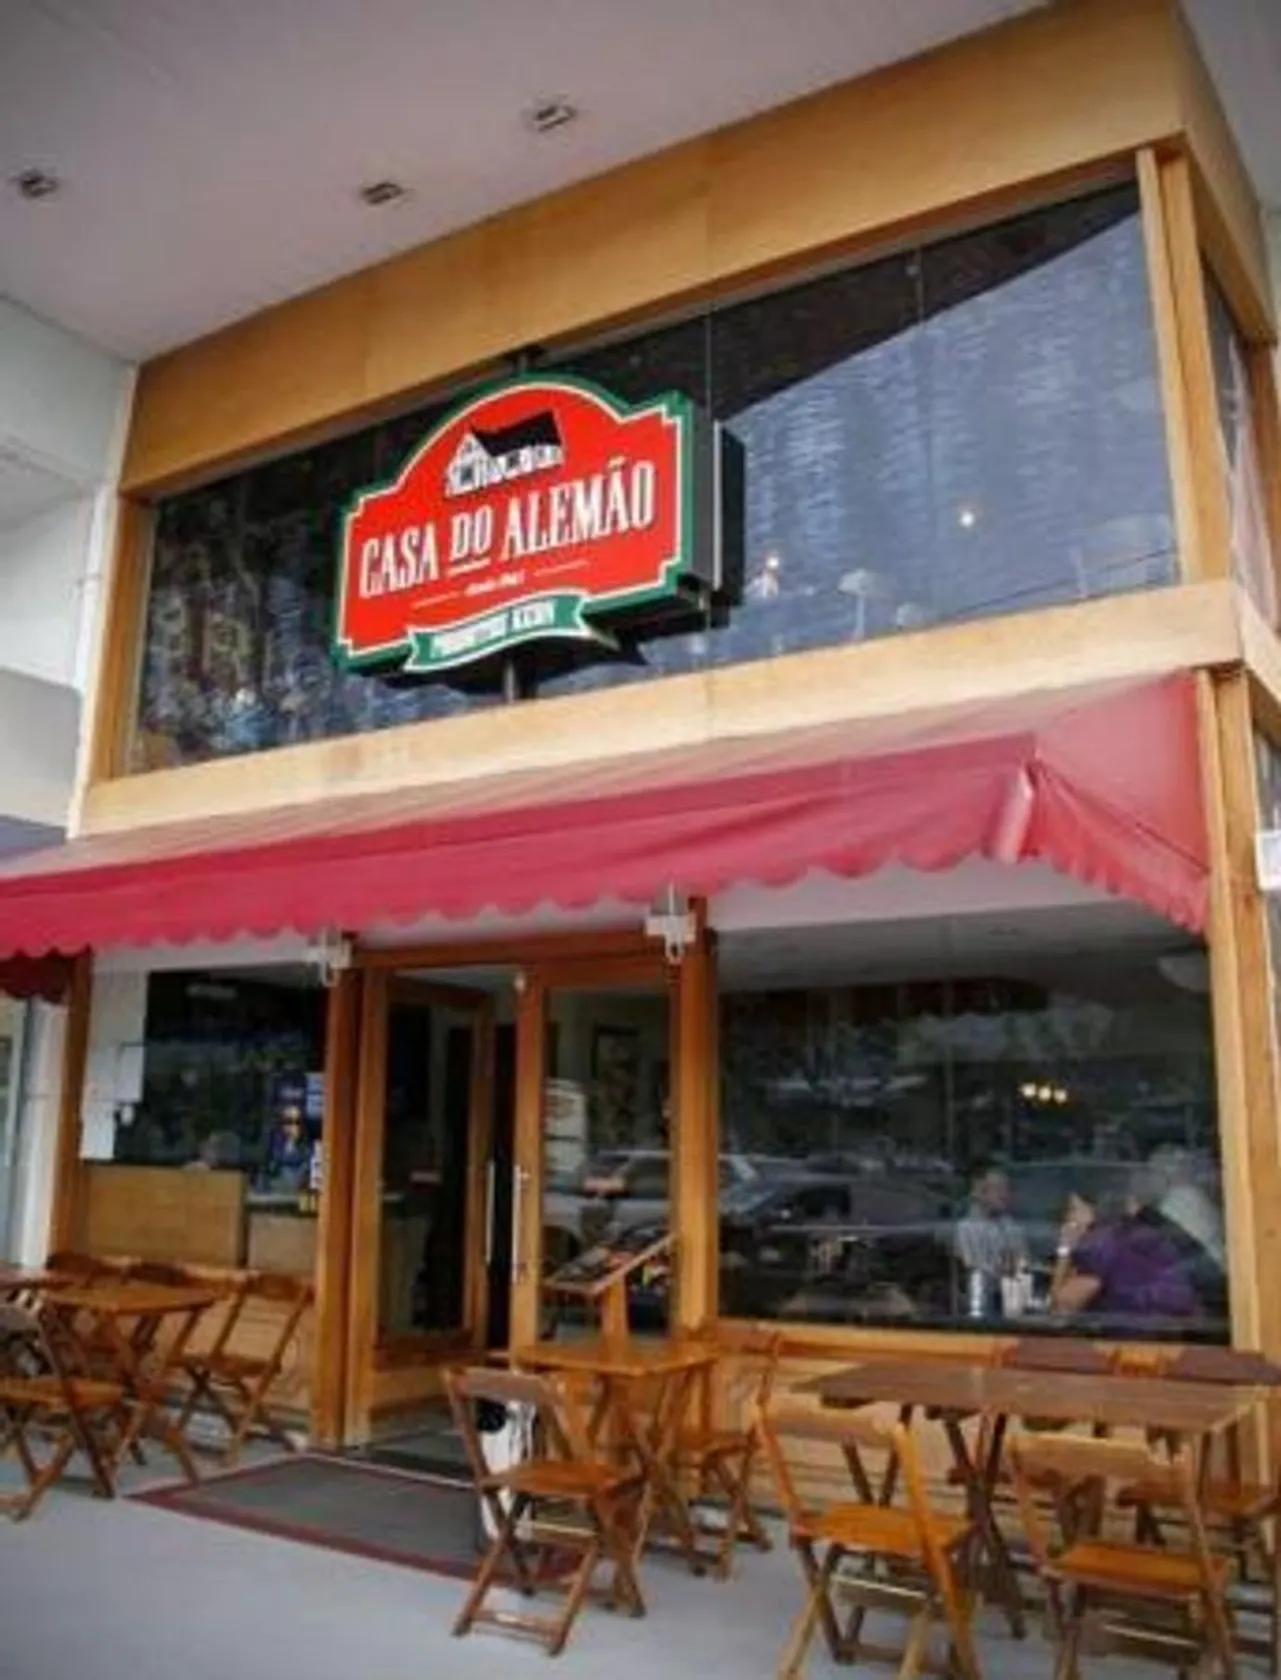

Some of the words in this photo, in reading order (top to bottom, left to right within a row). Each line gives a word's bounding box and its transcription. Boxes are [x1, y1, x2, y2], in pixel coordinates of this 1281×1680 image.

[358, 521, 440, 600] CASA
[449, 504, 494, 562] DO
[499, 454, 656, 562] ALEMÃO
